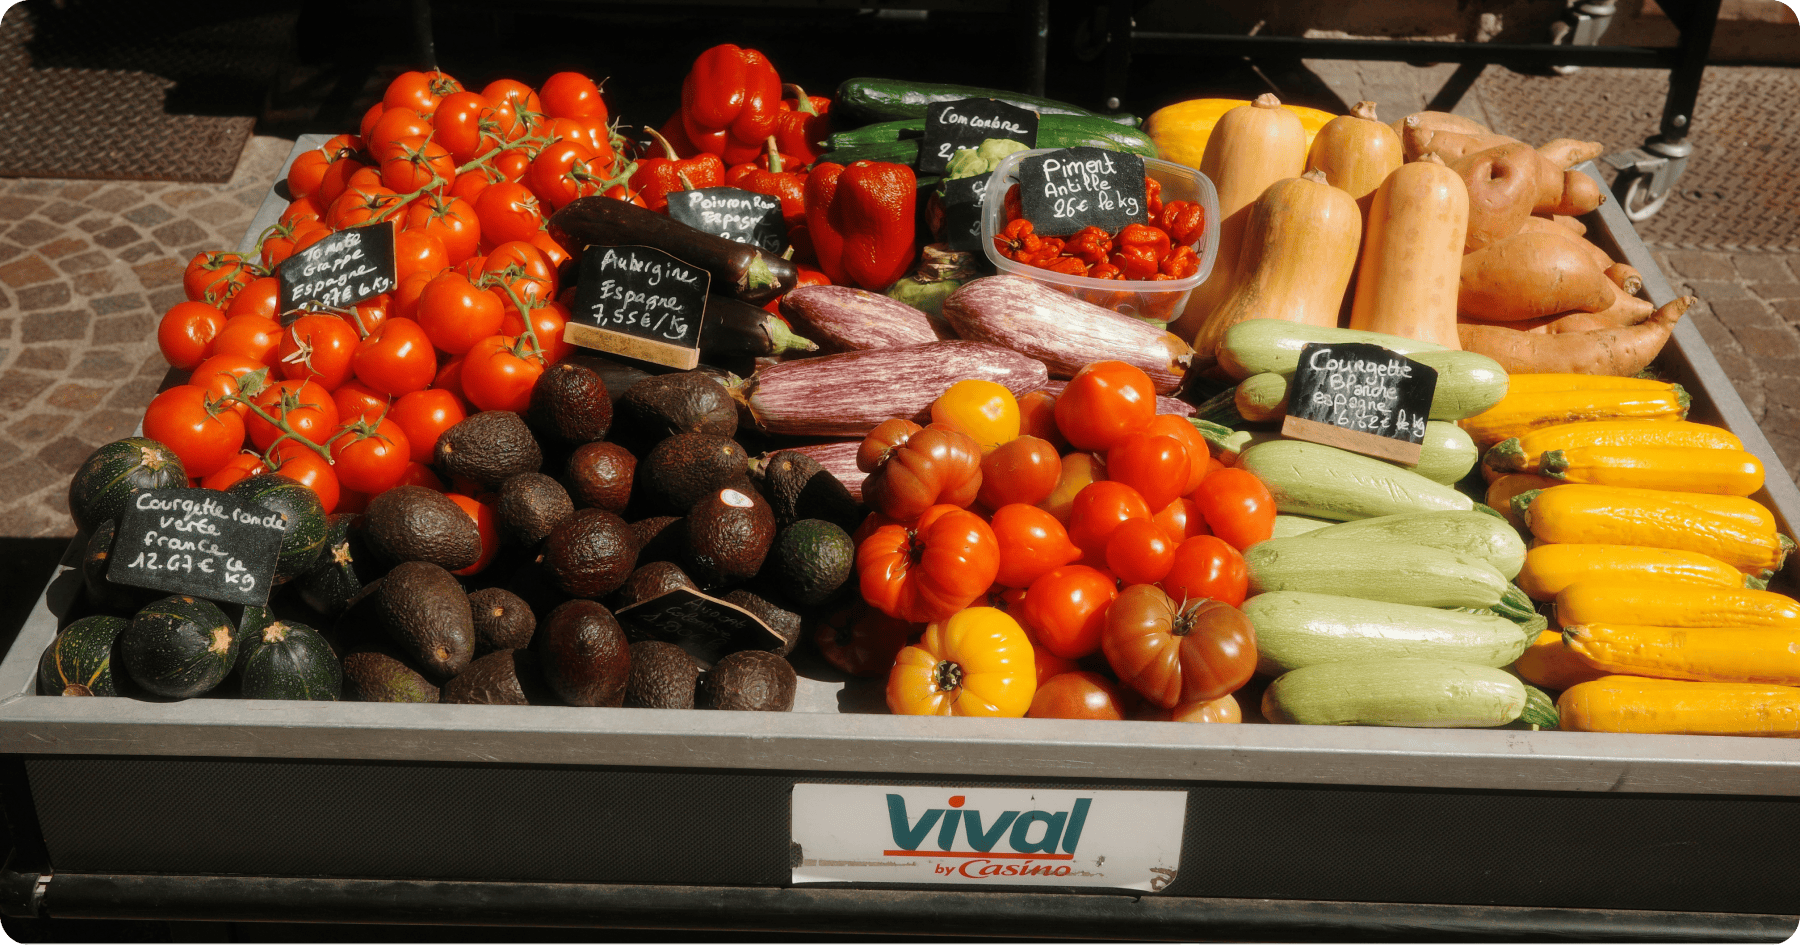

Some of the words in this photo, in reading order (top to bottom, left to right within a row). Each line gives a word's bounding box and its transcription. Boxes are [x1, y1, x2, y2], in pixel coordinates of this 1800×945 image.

[1042, 152, 1117, 182] Piment
[688, 191, 752, 210] Poivron
[1044, 173, 1111, 198] Antille
[600, 249, 698, 286] Aubergine
[292, 265, 378, 301] Espagne
[600, 279, 683, 310] Espagne
[934, 863, 956, 876] by
[958, 859, 1072, 879] Casino
